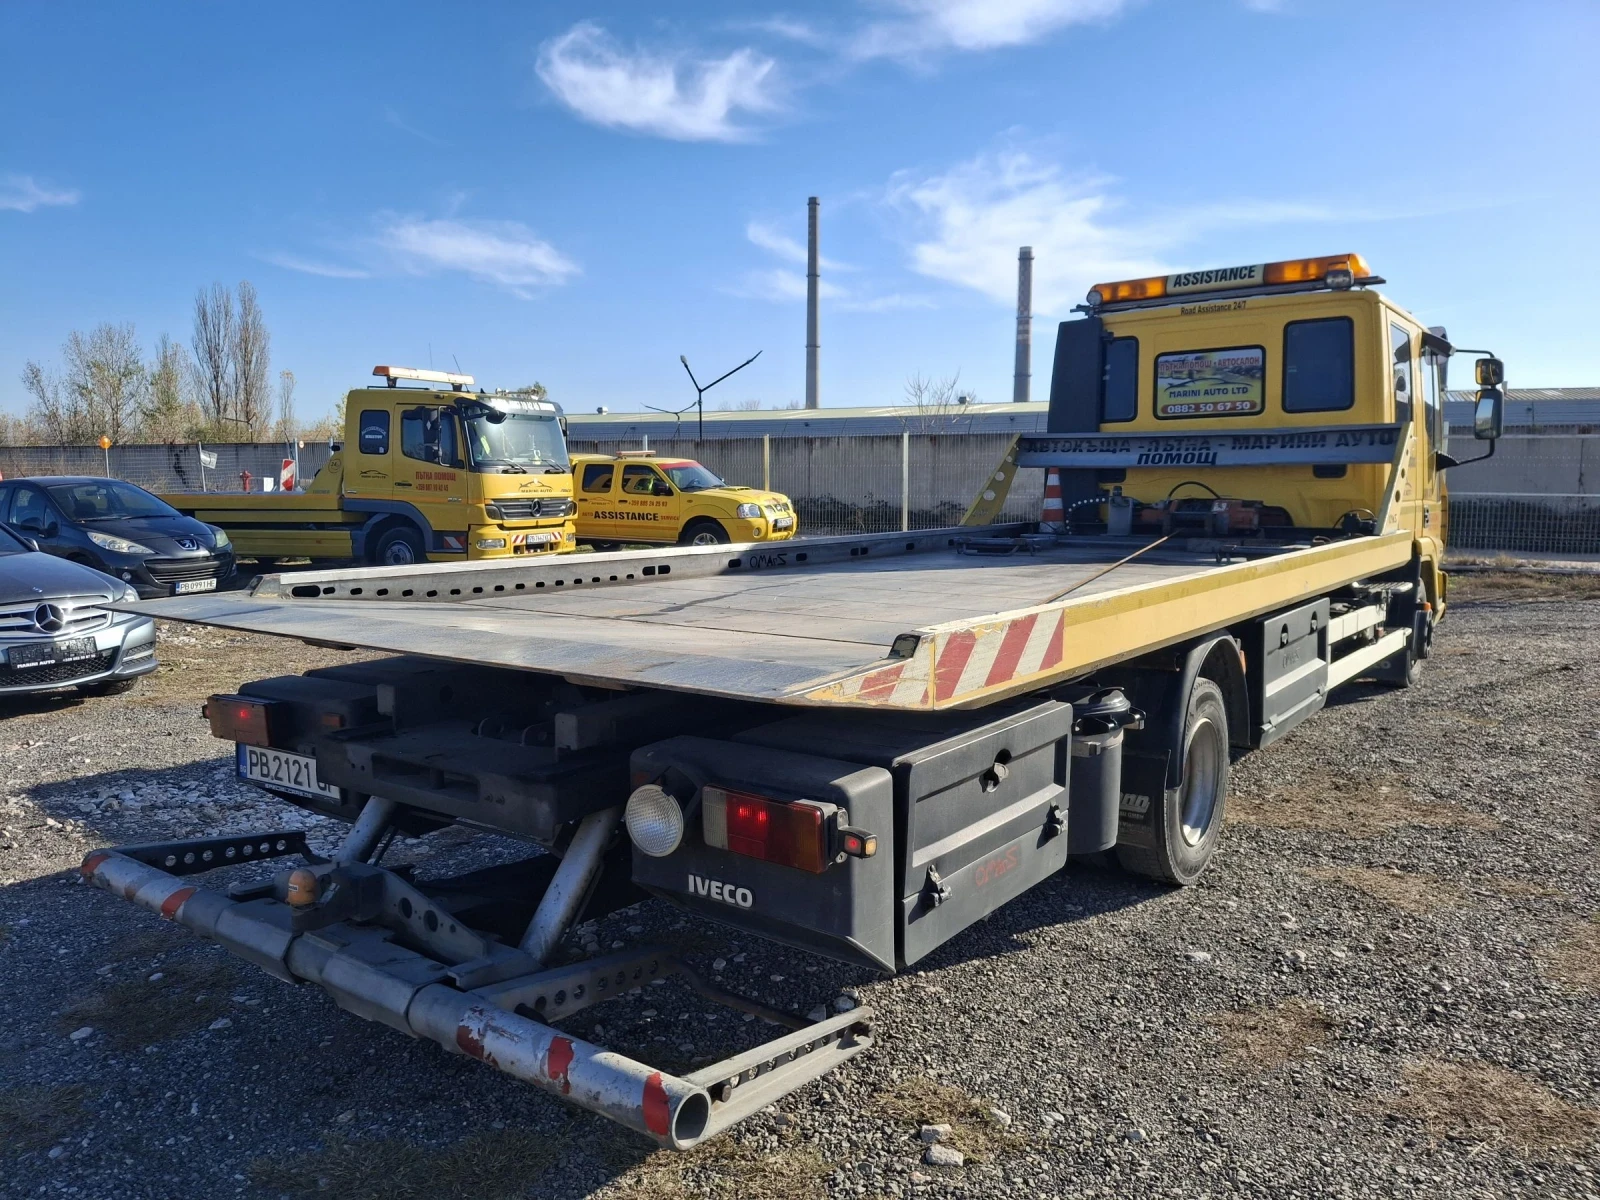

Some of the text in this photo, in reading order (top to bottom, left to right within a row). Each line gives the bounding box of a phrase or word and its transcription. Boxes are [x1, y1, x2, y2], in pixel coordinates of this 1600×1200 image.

[1173, 265, 1257, 288] ASSISTANCE
[1181, 300, 1247, 316] Road Assistance 24/7
[1169, 386, 1249, 398] MARINI AUTO LTD
[1167, 401, 1251, 413] 0882 50 67 50
[1137, 452, 1217, 465] ПОМОЩ
[594, 511, 659, 521] ASSISTANCE
[688, 874, 753, 908] IVECO
